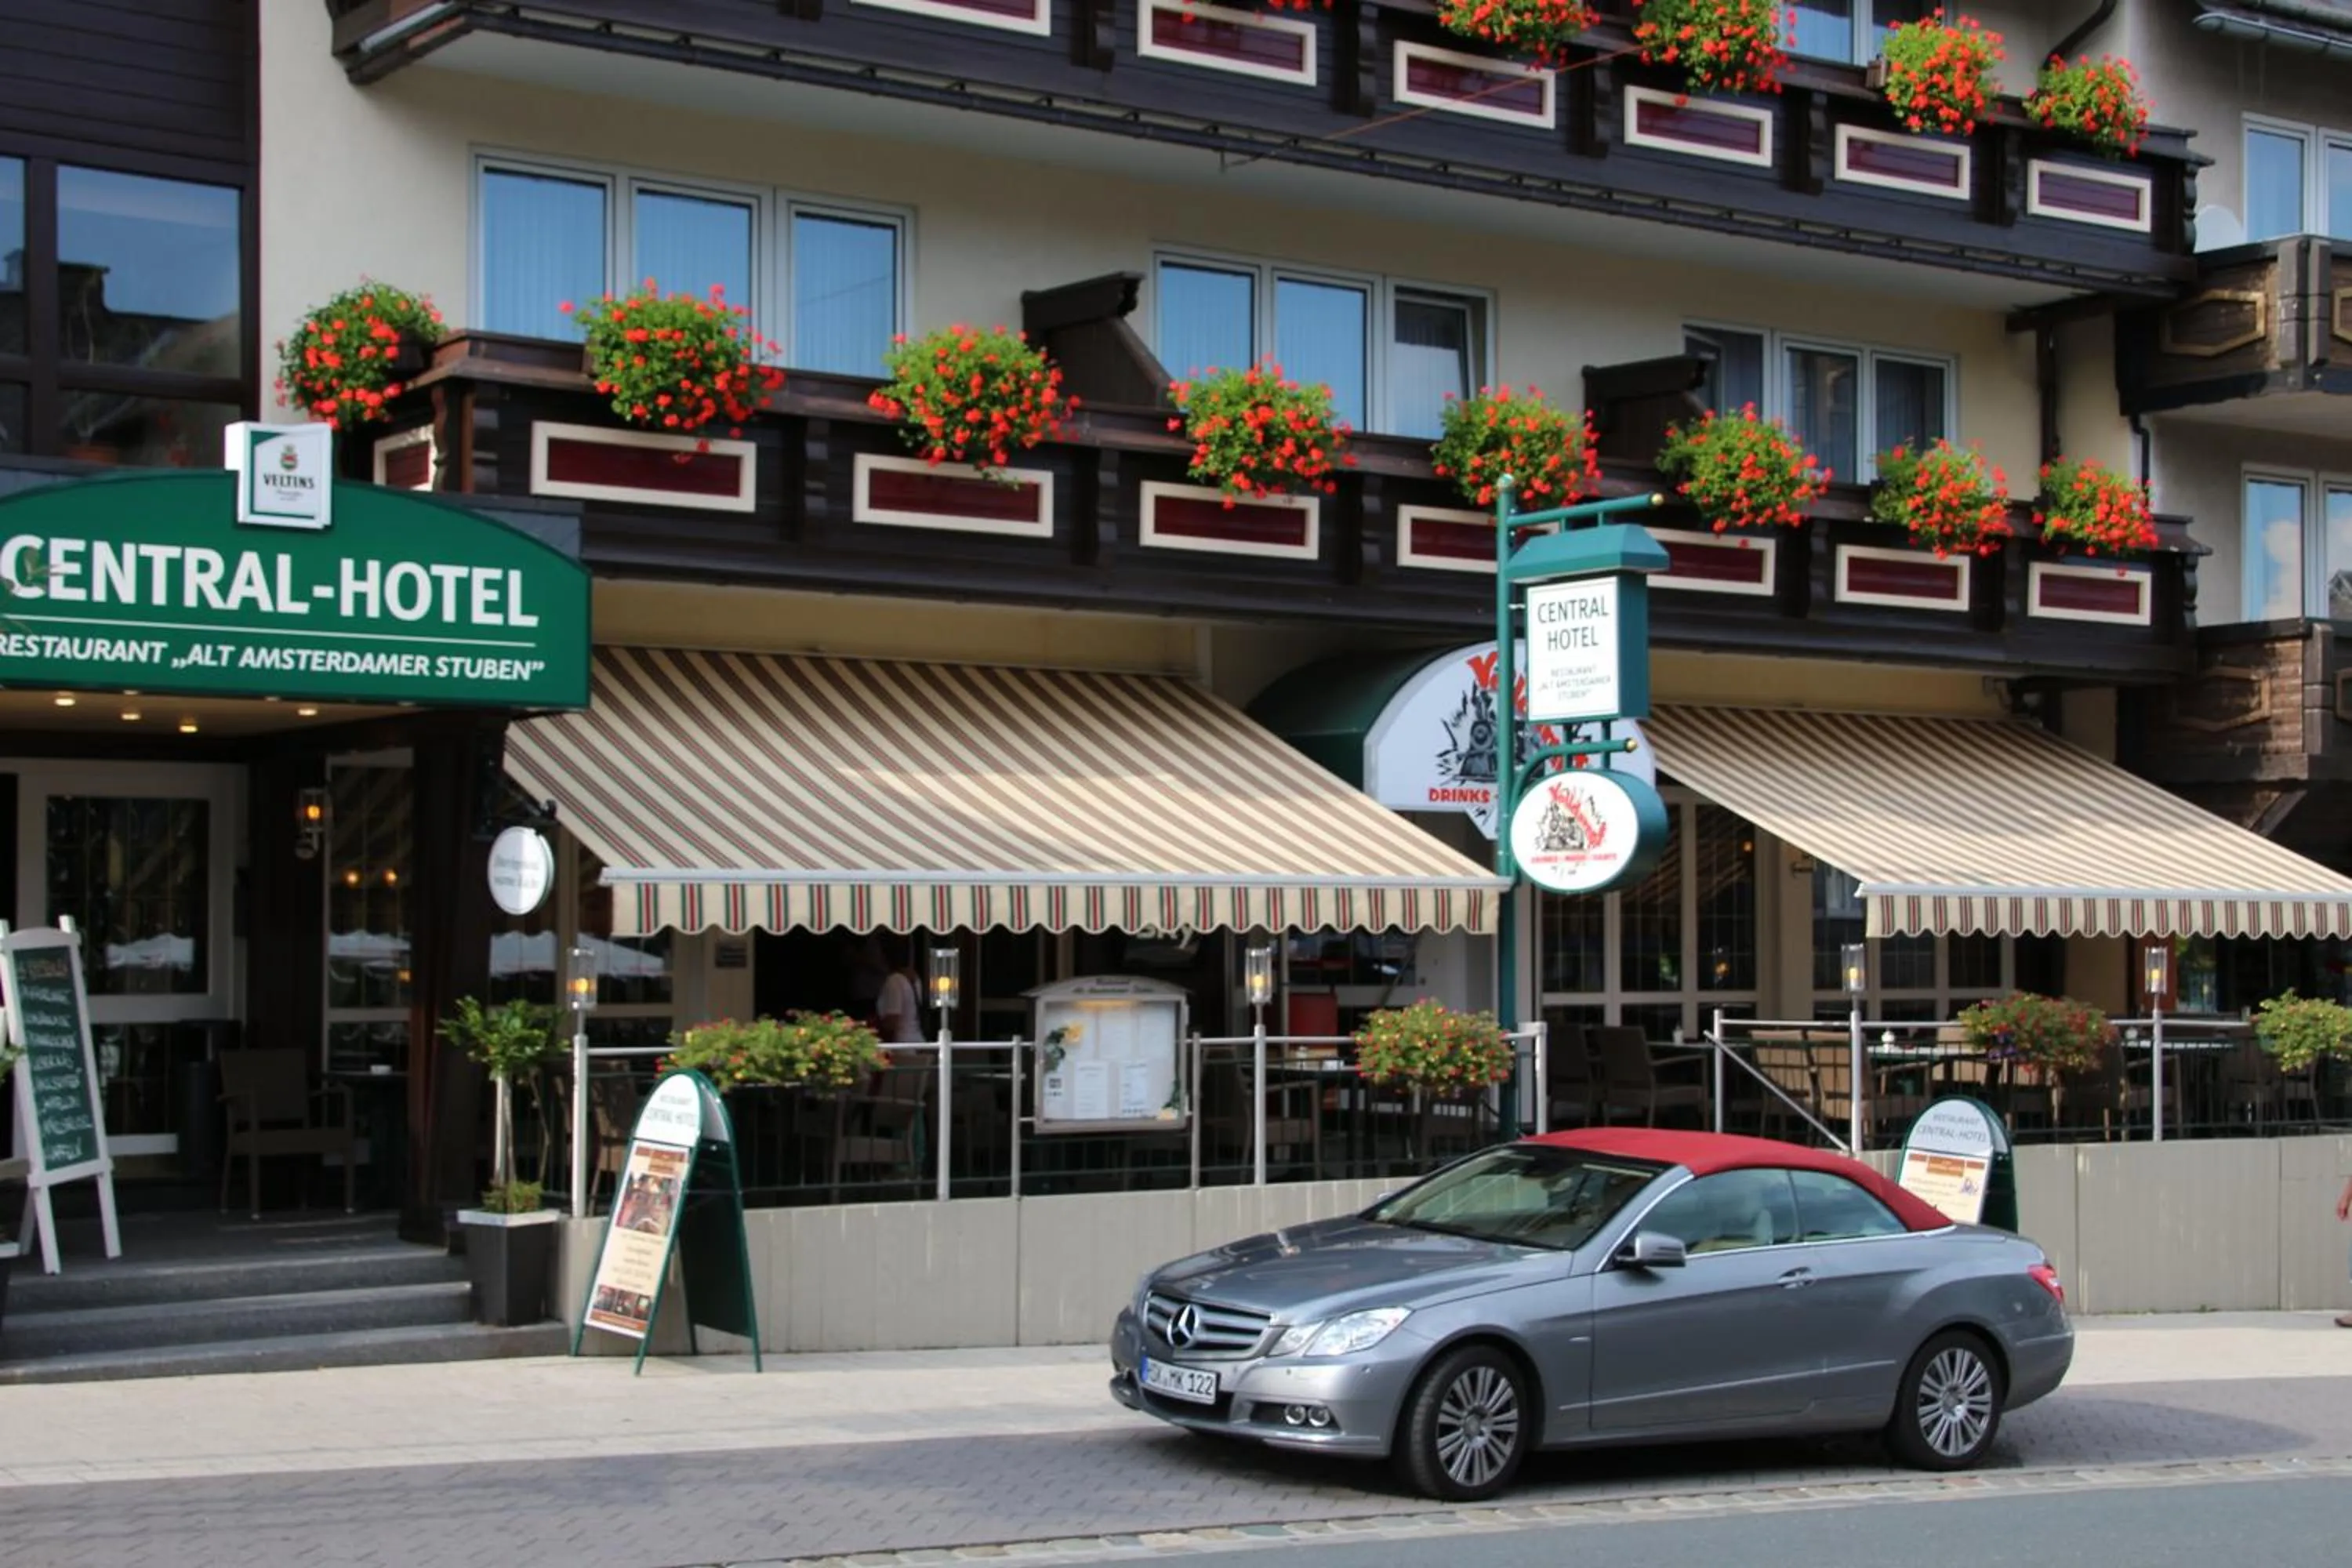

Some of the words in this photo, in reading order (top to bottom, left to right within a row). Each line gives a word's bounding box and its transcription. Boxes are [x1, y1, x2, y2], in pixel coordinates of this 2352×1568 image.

[263, 474, 314, 489] VELTINS
[1, 535, 539, 627] CENTRAL-HOTEL
[1537, 594, 1610, 623] CENTRAL
[1548, 626, 1599, 652] HOTEL
[0, 633, 169, 663] RESTAURANT
[238, 647, 430, 677] AMSTERDAMER
[1429, 788, 1490, 803] DRINKS
[1188, 1373, 1213, 1396] 122
